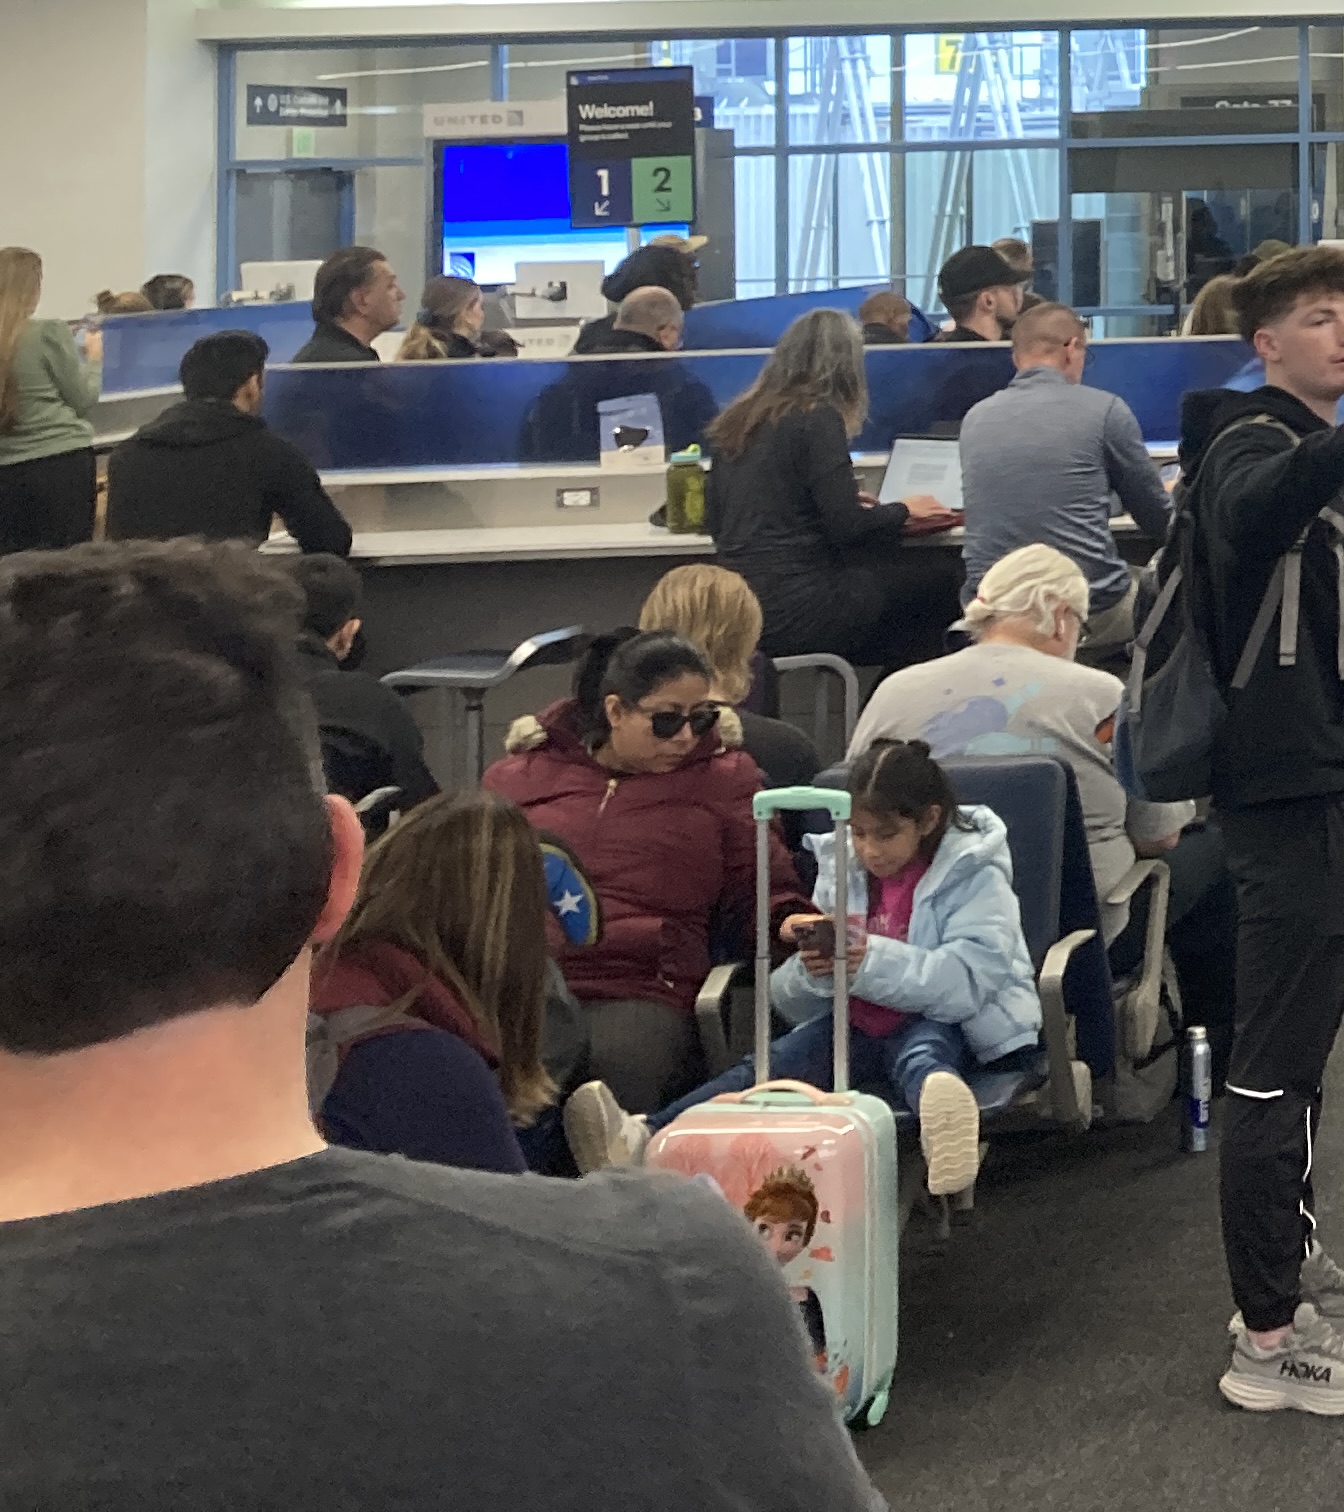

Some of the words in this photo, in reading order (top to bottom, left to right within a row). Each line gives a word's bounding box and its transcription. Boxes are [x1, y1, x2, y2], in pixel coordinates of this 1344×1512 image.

[434, 114, 503, 126] UNITED
[578, 100, 654, 120] Welcome!
[596, 168, 610, 197] 1
[652, 166, 672, 194] 2
